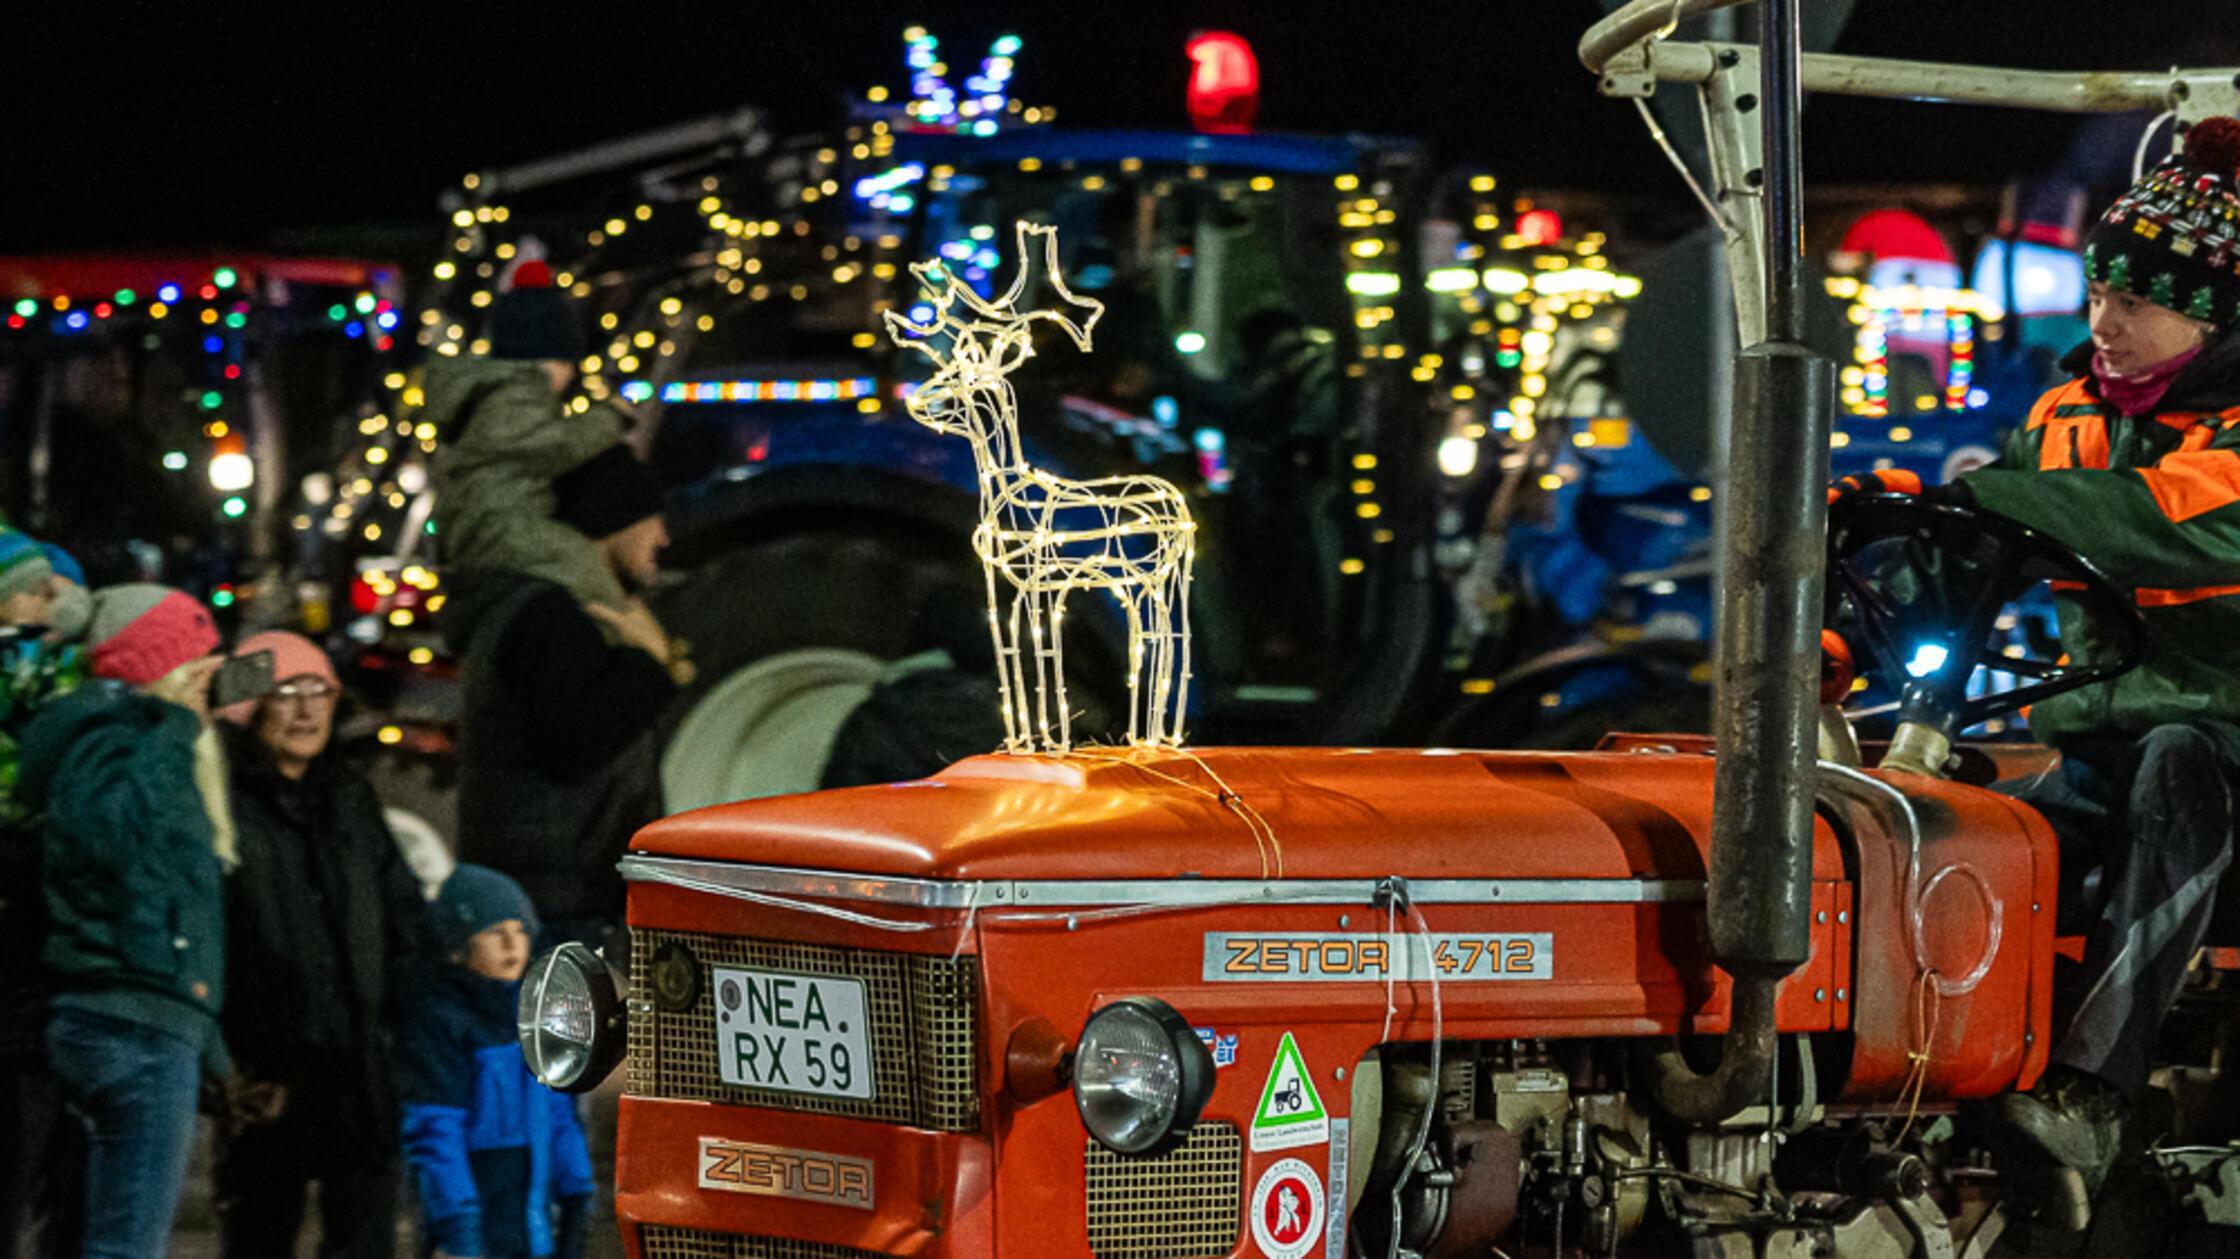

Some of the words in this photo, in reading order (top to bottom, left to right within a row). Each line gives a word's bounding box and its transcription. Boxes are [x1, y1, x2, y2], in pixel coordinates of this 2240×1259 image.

[1225, 938, 1389, 973] ZETOR
[1434, 939, 1535, 973] 4712
[747, 977, 830, 1032] NEA
[734, 1032, 789, 1084] RX
[804, 1040, 852, 1090] 59
[705, 1147, 869, 1200] ZETOR
